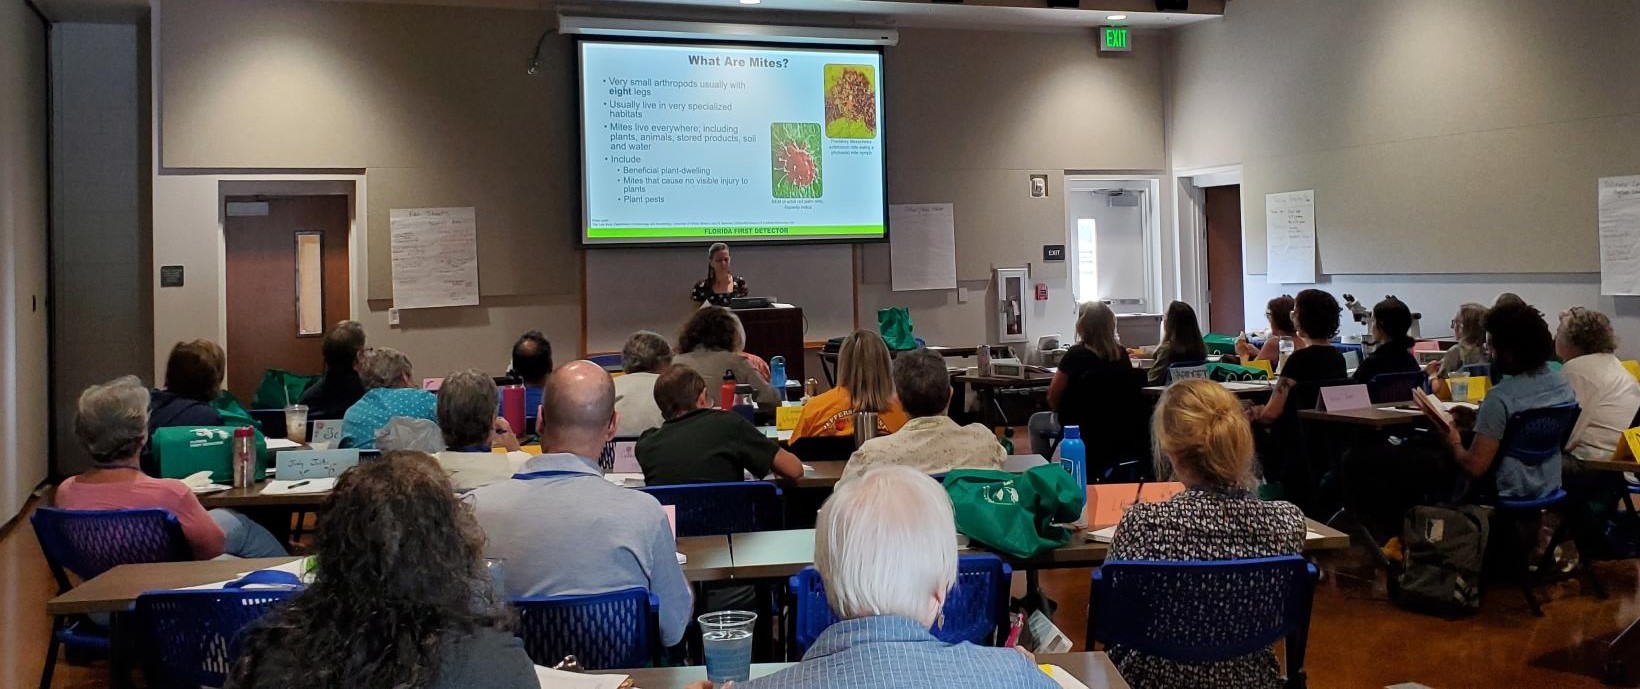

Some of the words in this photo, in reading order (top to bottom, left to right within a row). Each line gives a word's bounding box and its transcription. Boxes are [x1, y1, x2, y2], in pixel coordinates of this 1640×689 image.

[1106, 29, 1127, 48] EXIT
[688, 54, 721, 66] What
[724, 56, 745, 67] Are
[749, 57, 789, 69] Mites?
[608, 77, 627, 87] Very
[630, 78, 650, 87] small
[654, 79, 697, 89] arthropods
[700, 80, 727, 90] usually
[730, 81, 746, 90] with
[609, 87, 631, 98] eight
[633, 88, 651, 98] legs
[609, 100, 640, 110] Usually
[642, 100, 656, 109] live
[659, 101, 666, 109] in
[668, 102, 686, 112] very
[688, 102, 732, 112] specialized
[609, 109, 642, 118] habitats
[610, 123, 632, 131] Mites
[635, 123, 649, 131] live
[703, 125, 738, 135] including
[610, 132, 638, 142] plants,
[640, 133, 675, 143] animals,
[676, 133, 702, 142] stored
[704, 134, 741, 144] products,
[743, 135, 757, 143] soil
[610, 142, 626, 150] and
[629, 142, 651, 151] water
[610, 155, 641, 164] Include
[623, 166, 659, 174] Beneficial
[661, 167, 711, 176] plant-dwelling
[696, 177, 719, 185] visible
[720, 178, 740, 187] injury
[623, 186, 646, 195] plants
[645, 196, 665, 205] pests
